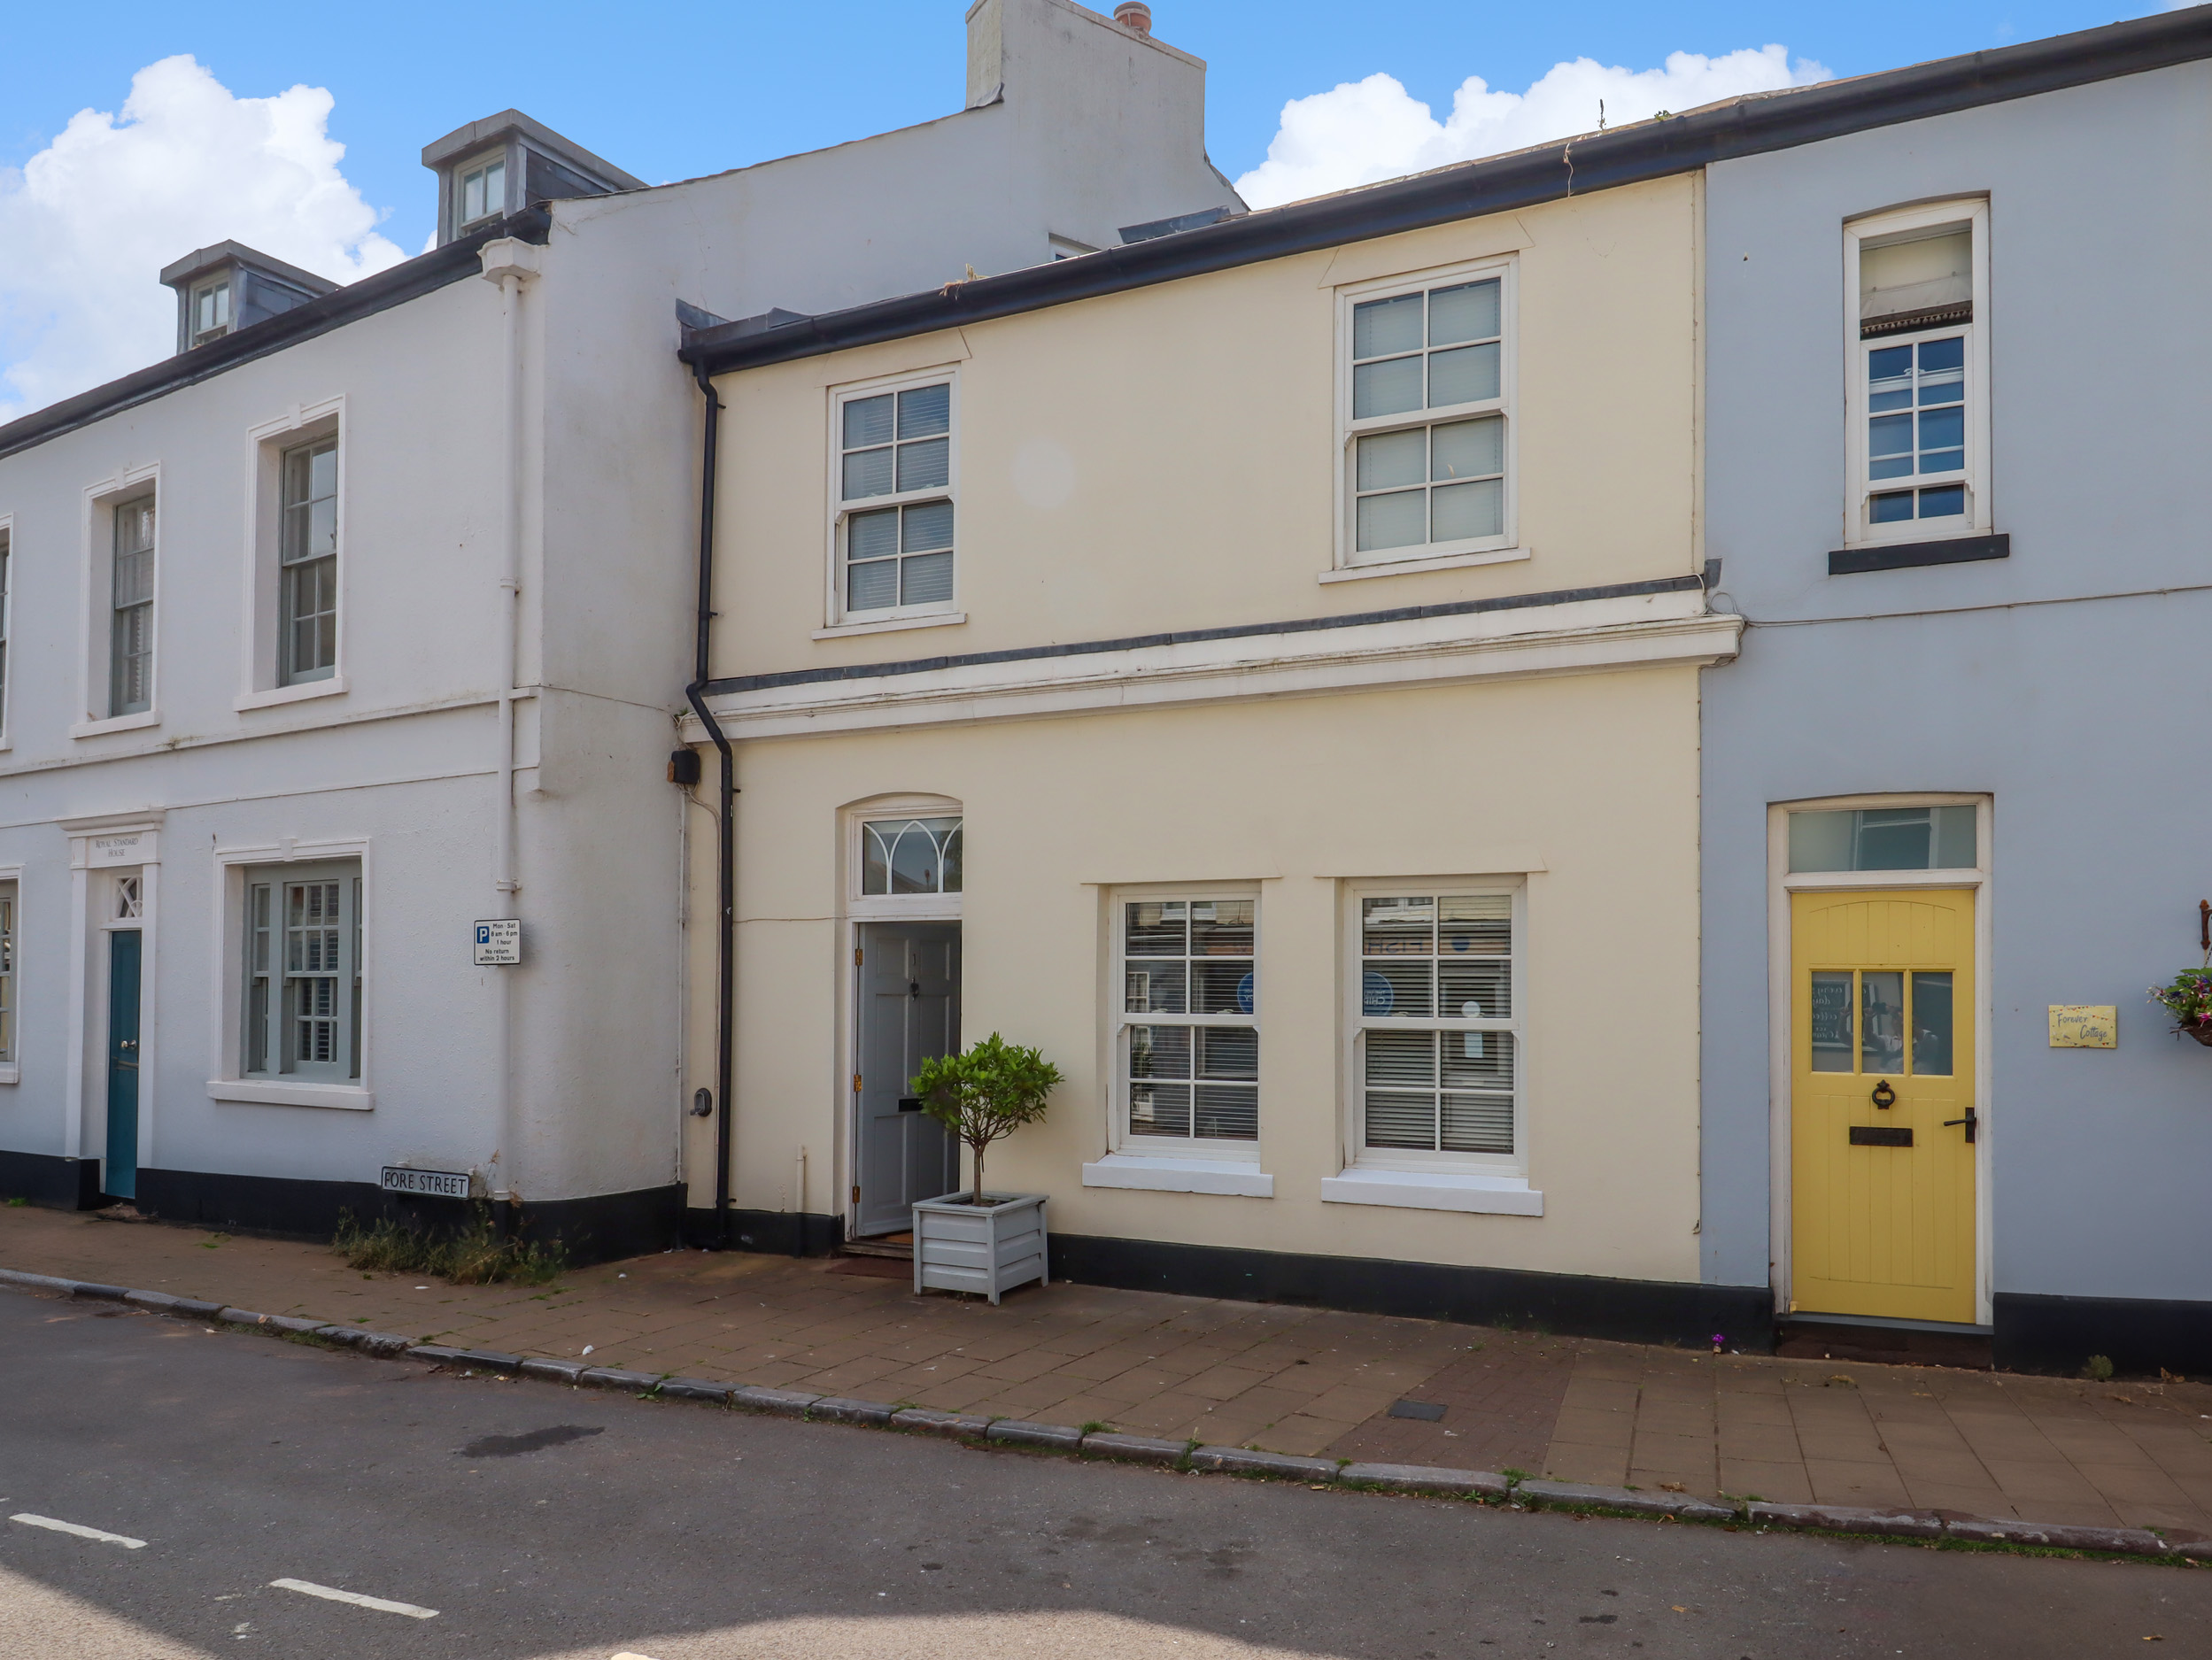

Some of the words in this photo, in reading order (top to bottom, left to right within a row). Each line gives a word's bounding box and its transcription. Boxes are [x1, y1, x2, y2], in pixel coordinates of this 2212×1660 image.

[479, 928, 488, 942] P
[2057, 1013, 2088, 1027] Forever
[2079, 1024, 2108, 1042] Cottage
[384, 1171, 414, 1189] FORE
[419, 1174, 467, 1194] STREET
